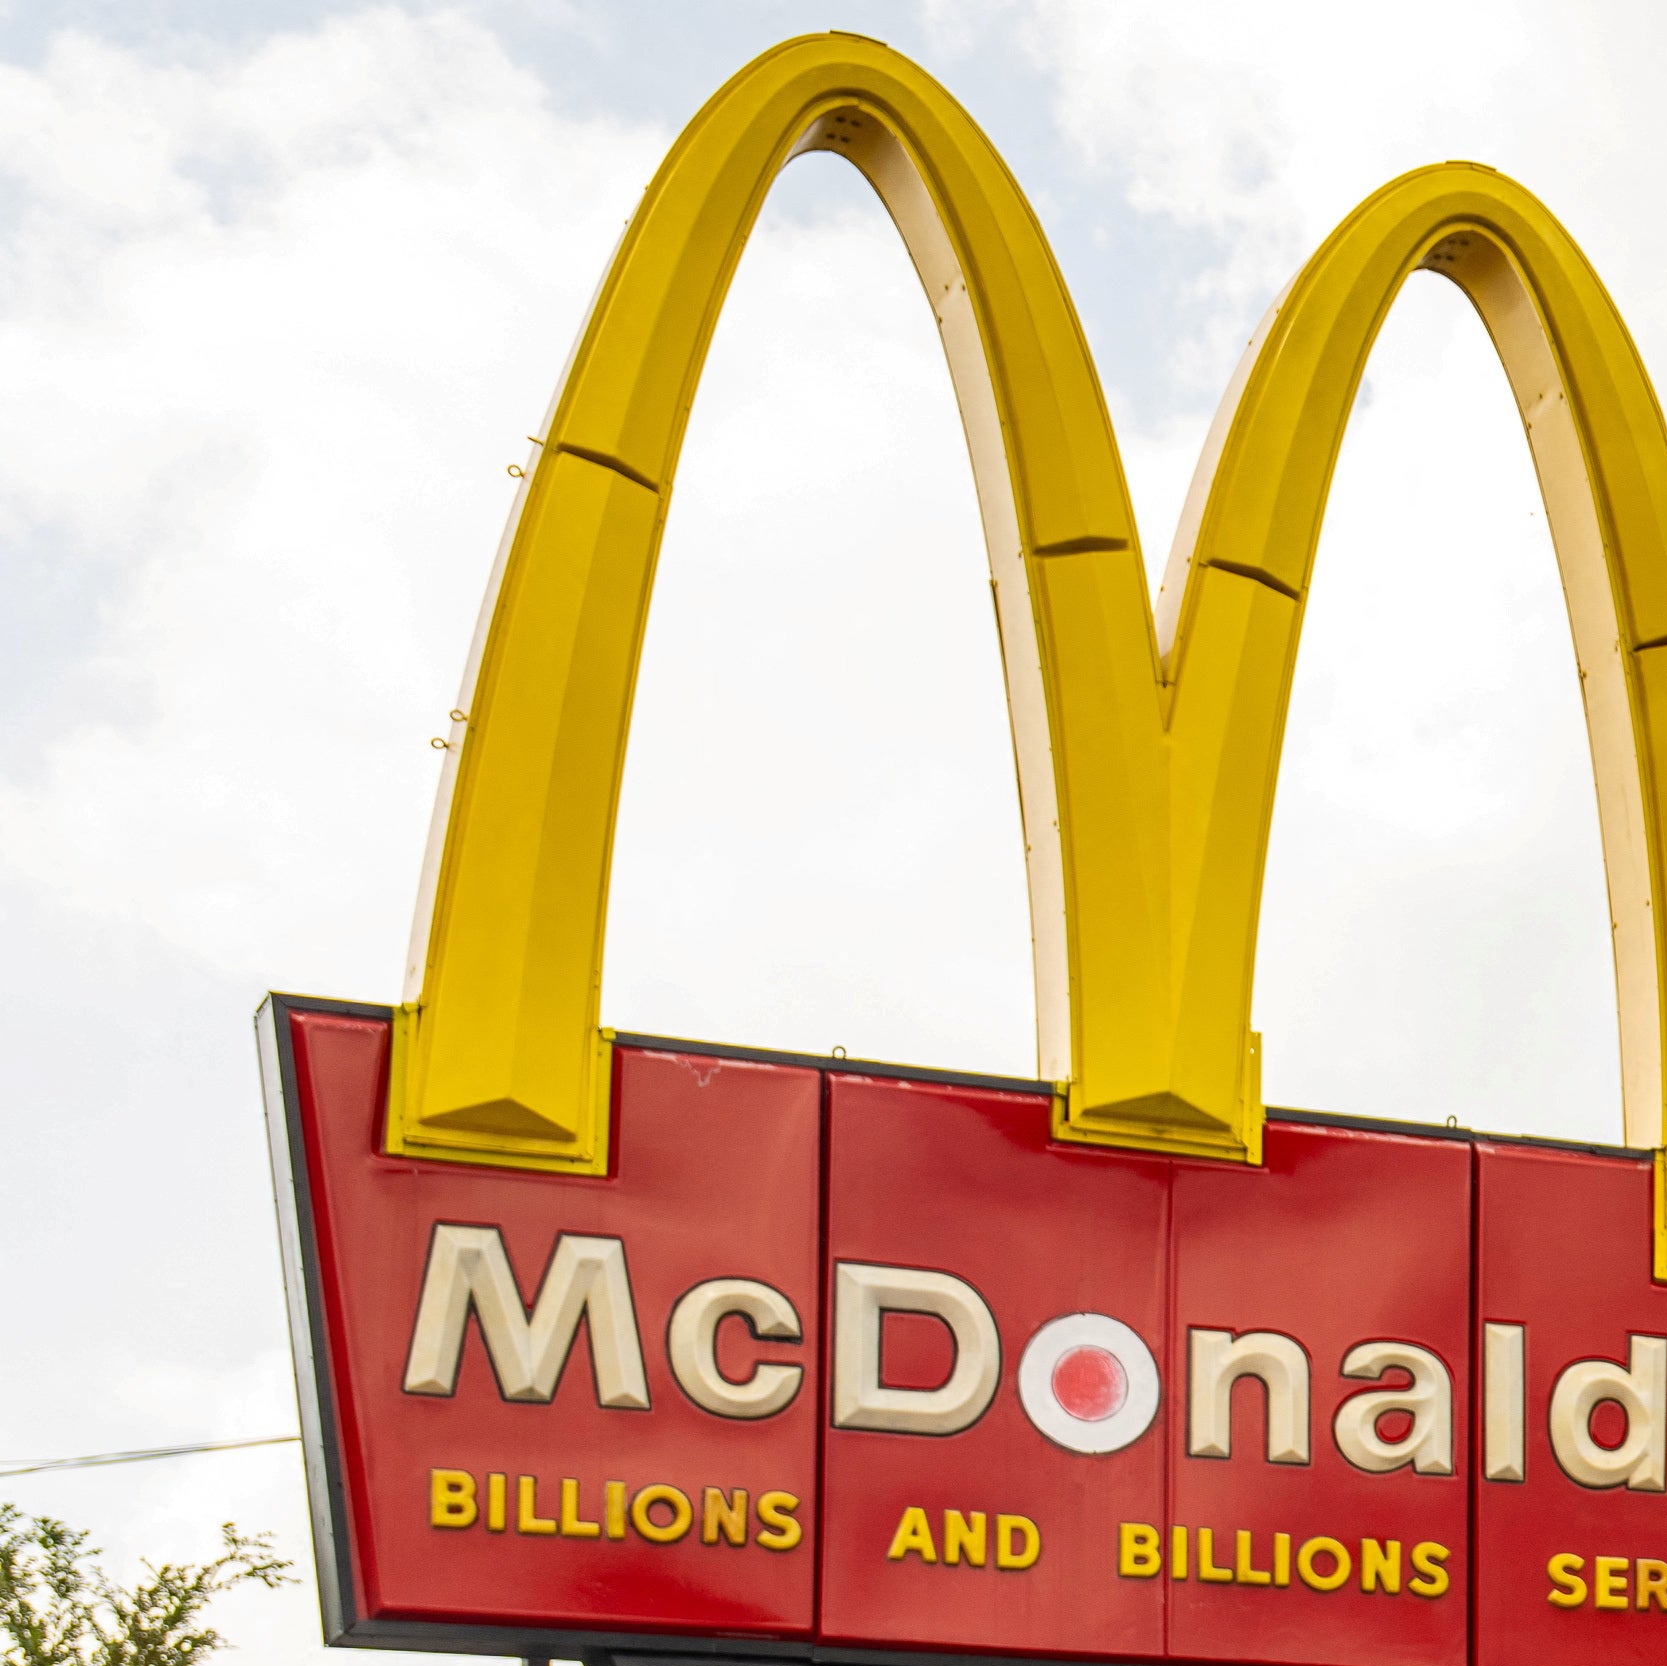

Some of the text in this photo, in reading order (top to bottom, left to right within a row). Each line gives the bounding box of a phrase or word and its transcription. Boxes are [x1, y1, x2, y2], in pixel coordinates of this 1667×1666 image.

[428, 1467, 803, 1554] BILLIONS
[887, 1506, 1041, 1572] AND
[1117, 1523, 1451, 1600] BILLIONS
